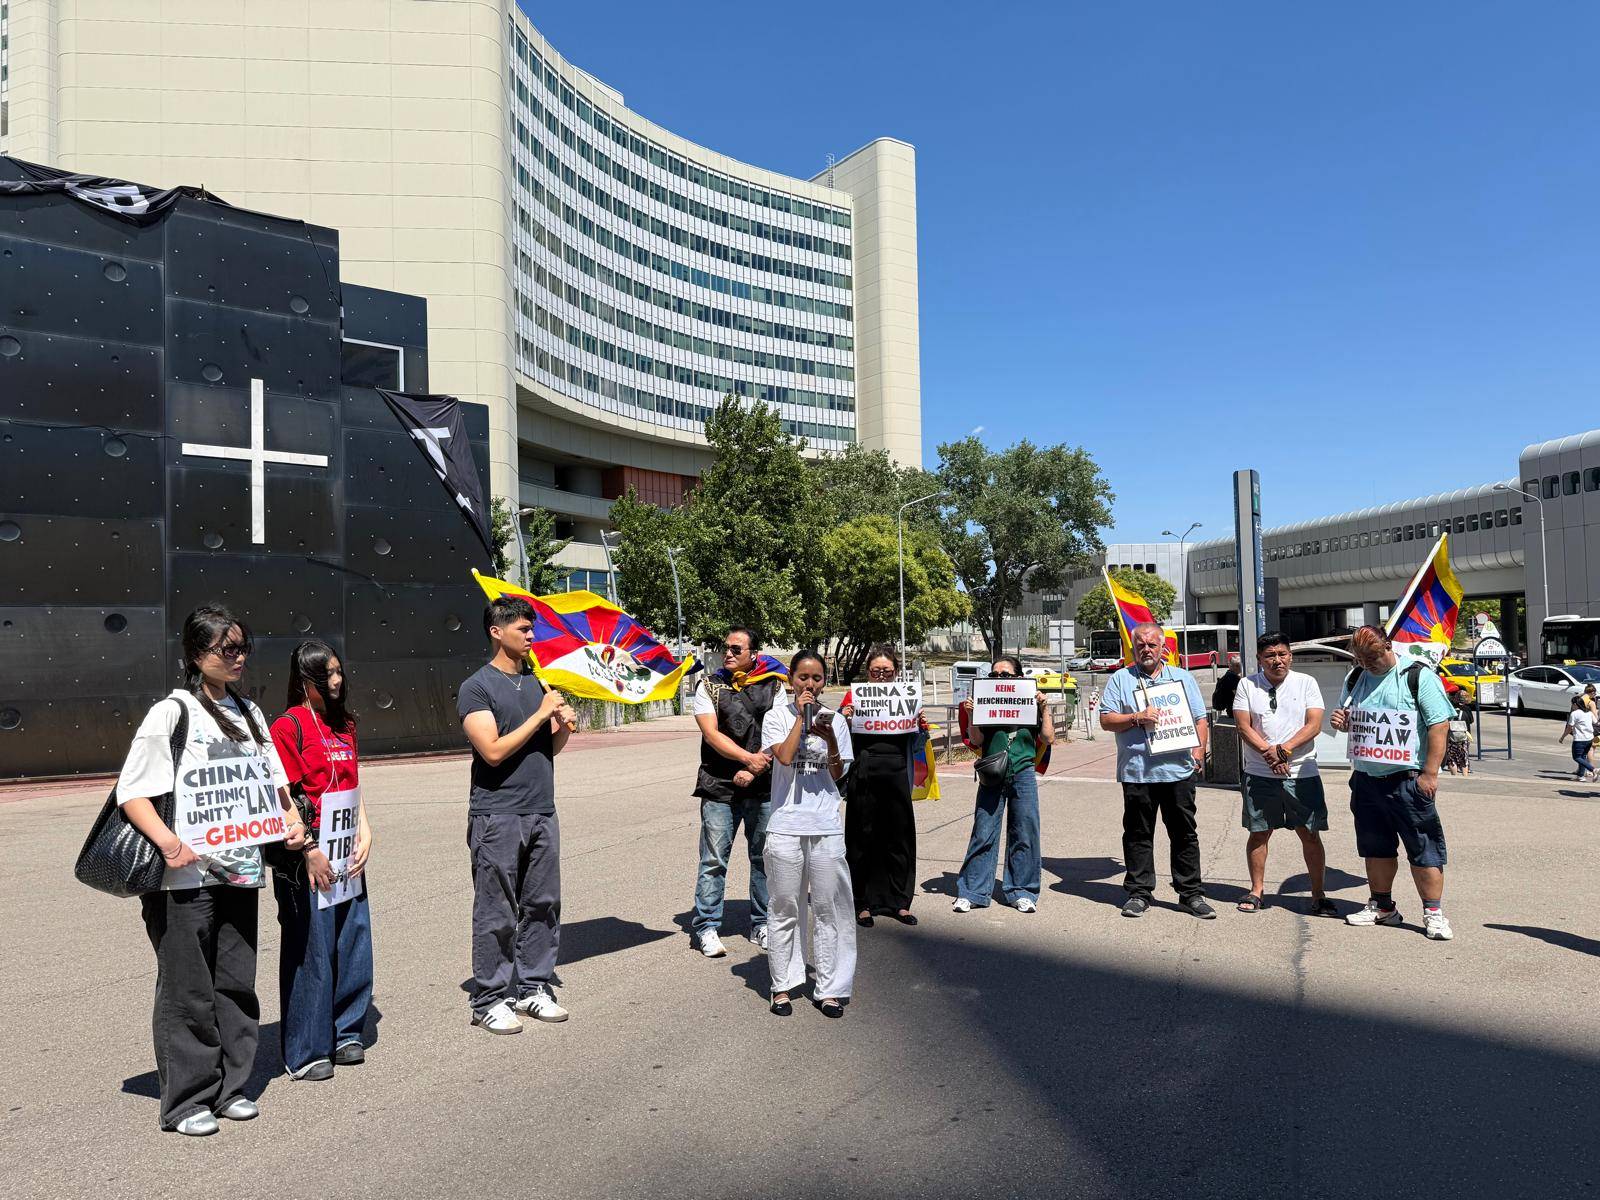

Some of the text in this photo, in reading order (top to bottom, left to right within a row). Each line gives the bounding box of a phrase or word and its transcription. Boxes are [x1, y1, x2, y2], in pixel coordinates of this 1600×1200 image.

[995, 684, 1016, 693] KEINE
[889, 698, 919, 717] LAW
[977, 697, 1034, 705] MENCHENRECHTE
[989, 709, 1020, 718] IN TIBET
[1375, 726, 1412, 748] LAW
[245, 784, 278, 816] LAW
[332, 805, 359, 833] FRE
